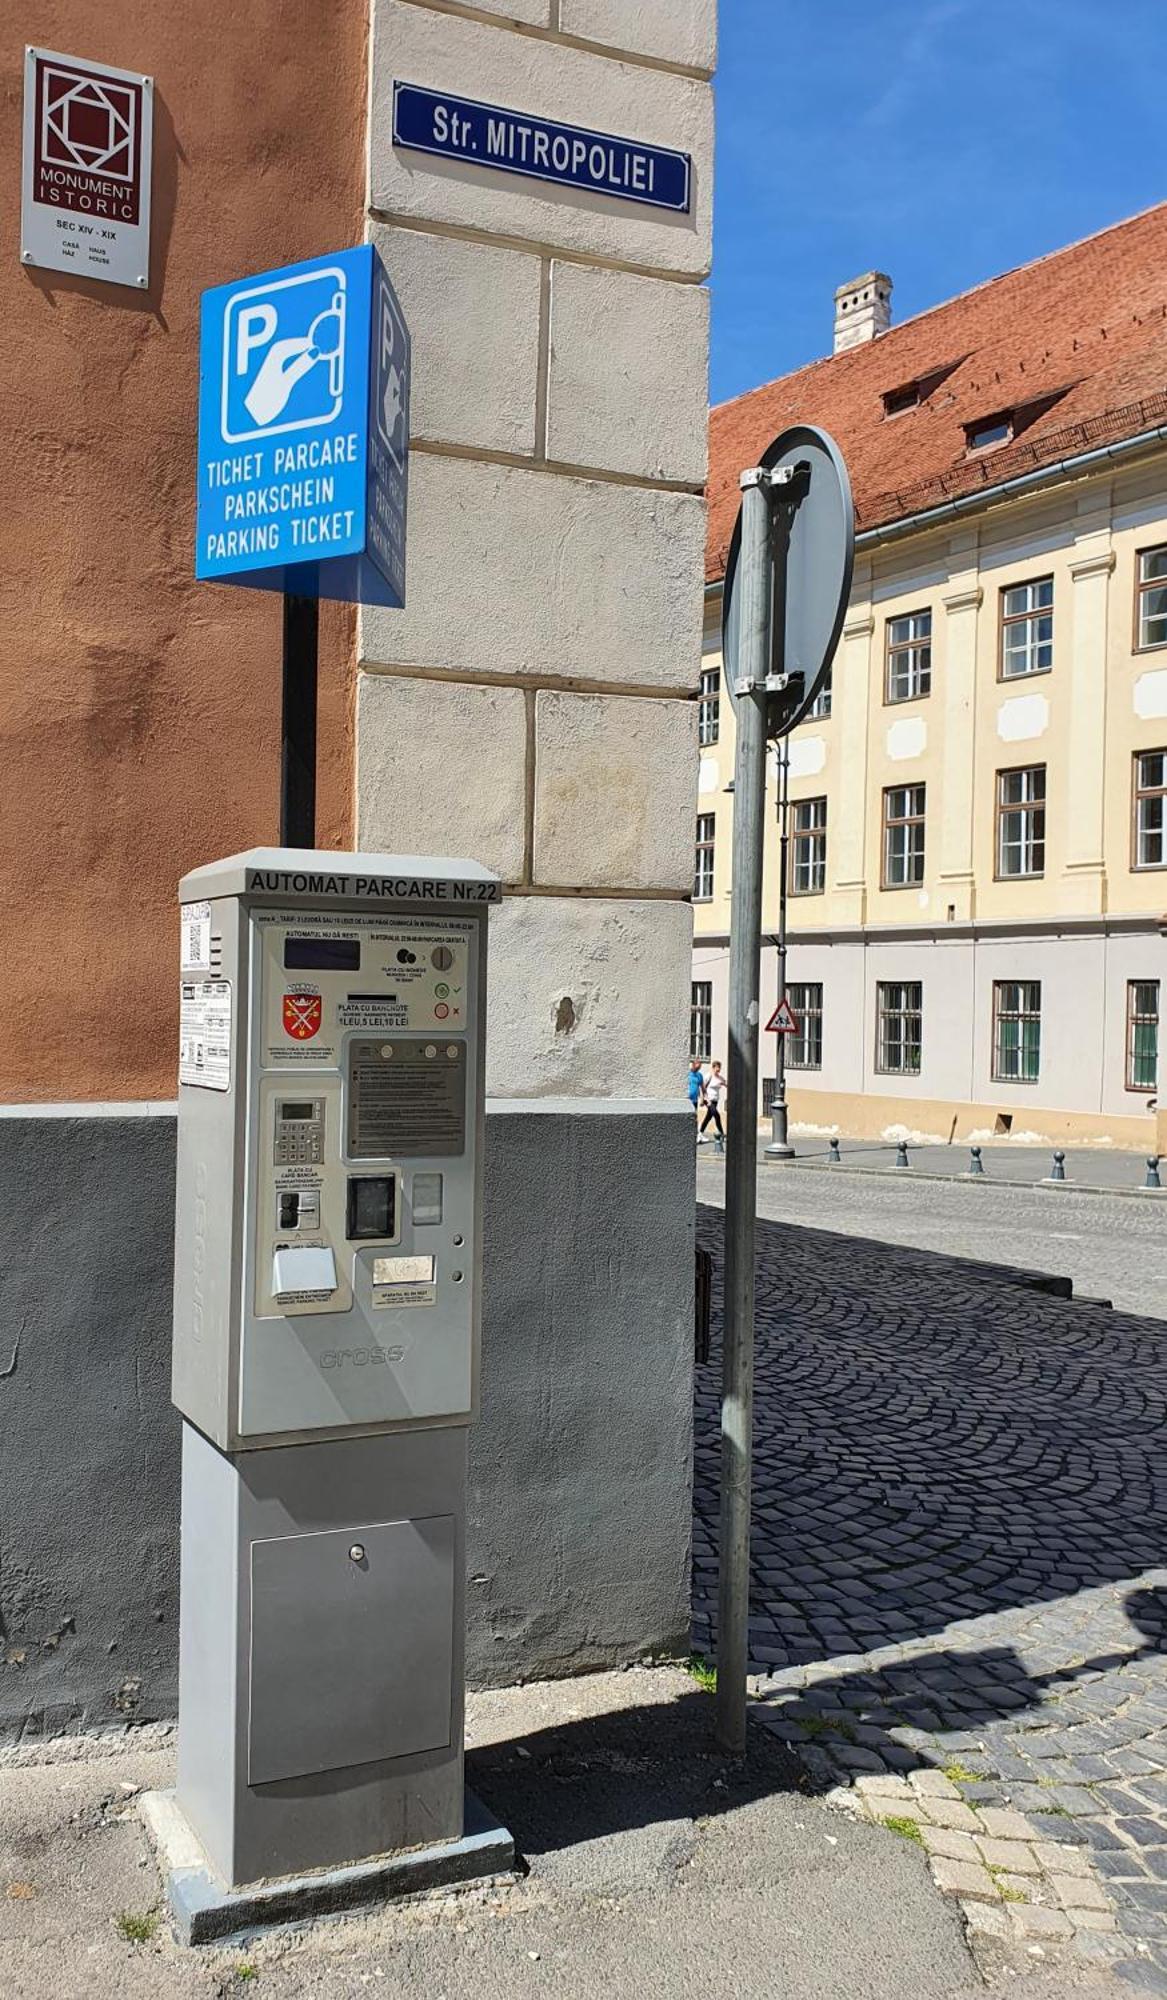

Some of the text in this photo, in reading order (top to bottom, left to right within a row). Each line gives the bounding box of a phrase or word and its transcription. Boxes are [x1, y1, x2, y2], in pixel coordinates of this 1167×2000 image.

[433, 105, 655, 192] Str. MITROPOLIEI
[41, 167, 133, 201] MONUMENT
[41, 185, 133, 219] ISTORIC
[56, 219, 76, 232] SEC
[77, 224, 94, 235] XIV
[101, 229, 117, 241] XIX
[236, 303, 278, 376] P
[207, 433, 358, 488] TICHET PARCARE
[224, 476, 335, 521] PARKSCHEIN
[207, 523, 280, 560] PARKING
[290, 510, 354, 546] TICKET
[250, 872, 498, 901] AUTOMAT PARCARE Nr.22
[338, 1004, 359, 1012] PLATA
[360, 1004, 371, 1012] CU
